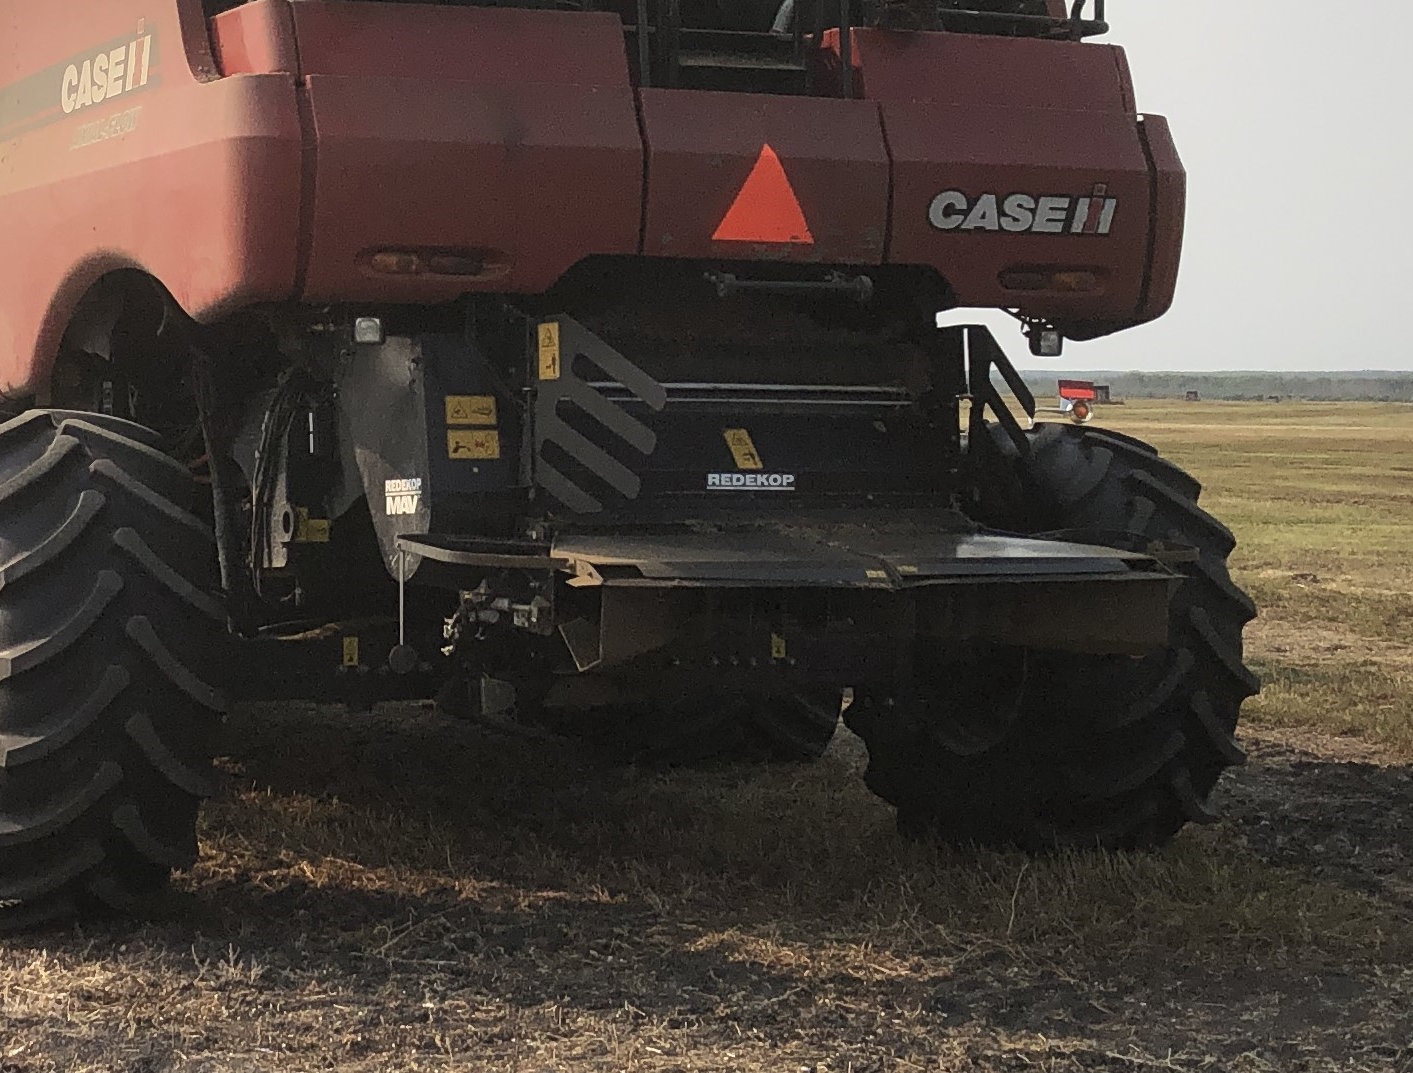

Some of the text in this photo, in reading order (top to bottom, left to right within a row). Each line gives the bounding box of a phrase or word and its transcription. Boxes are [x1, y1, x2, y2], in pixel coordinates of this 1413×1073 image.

[61, 44, 126, 114] CASE
[928, 190, 1070, 232] CASE
[384, 477, 422, 493] REDEKOP
[707, 473, 795, 486] REDEKOP
[385, 495, 418, 516] MAV
